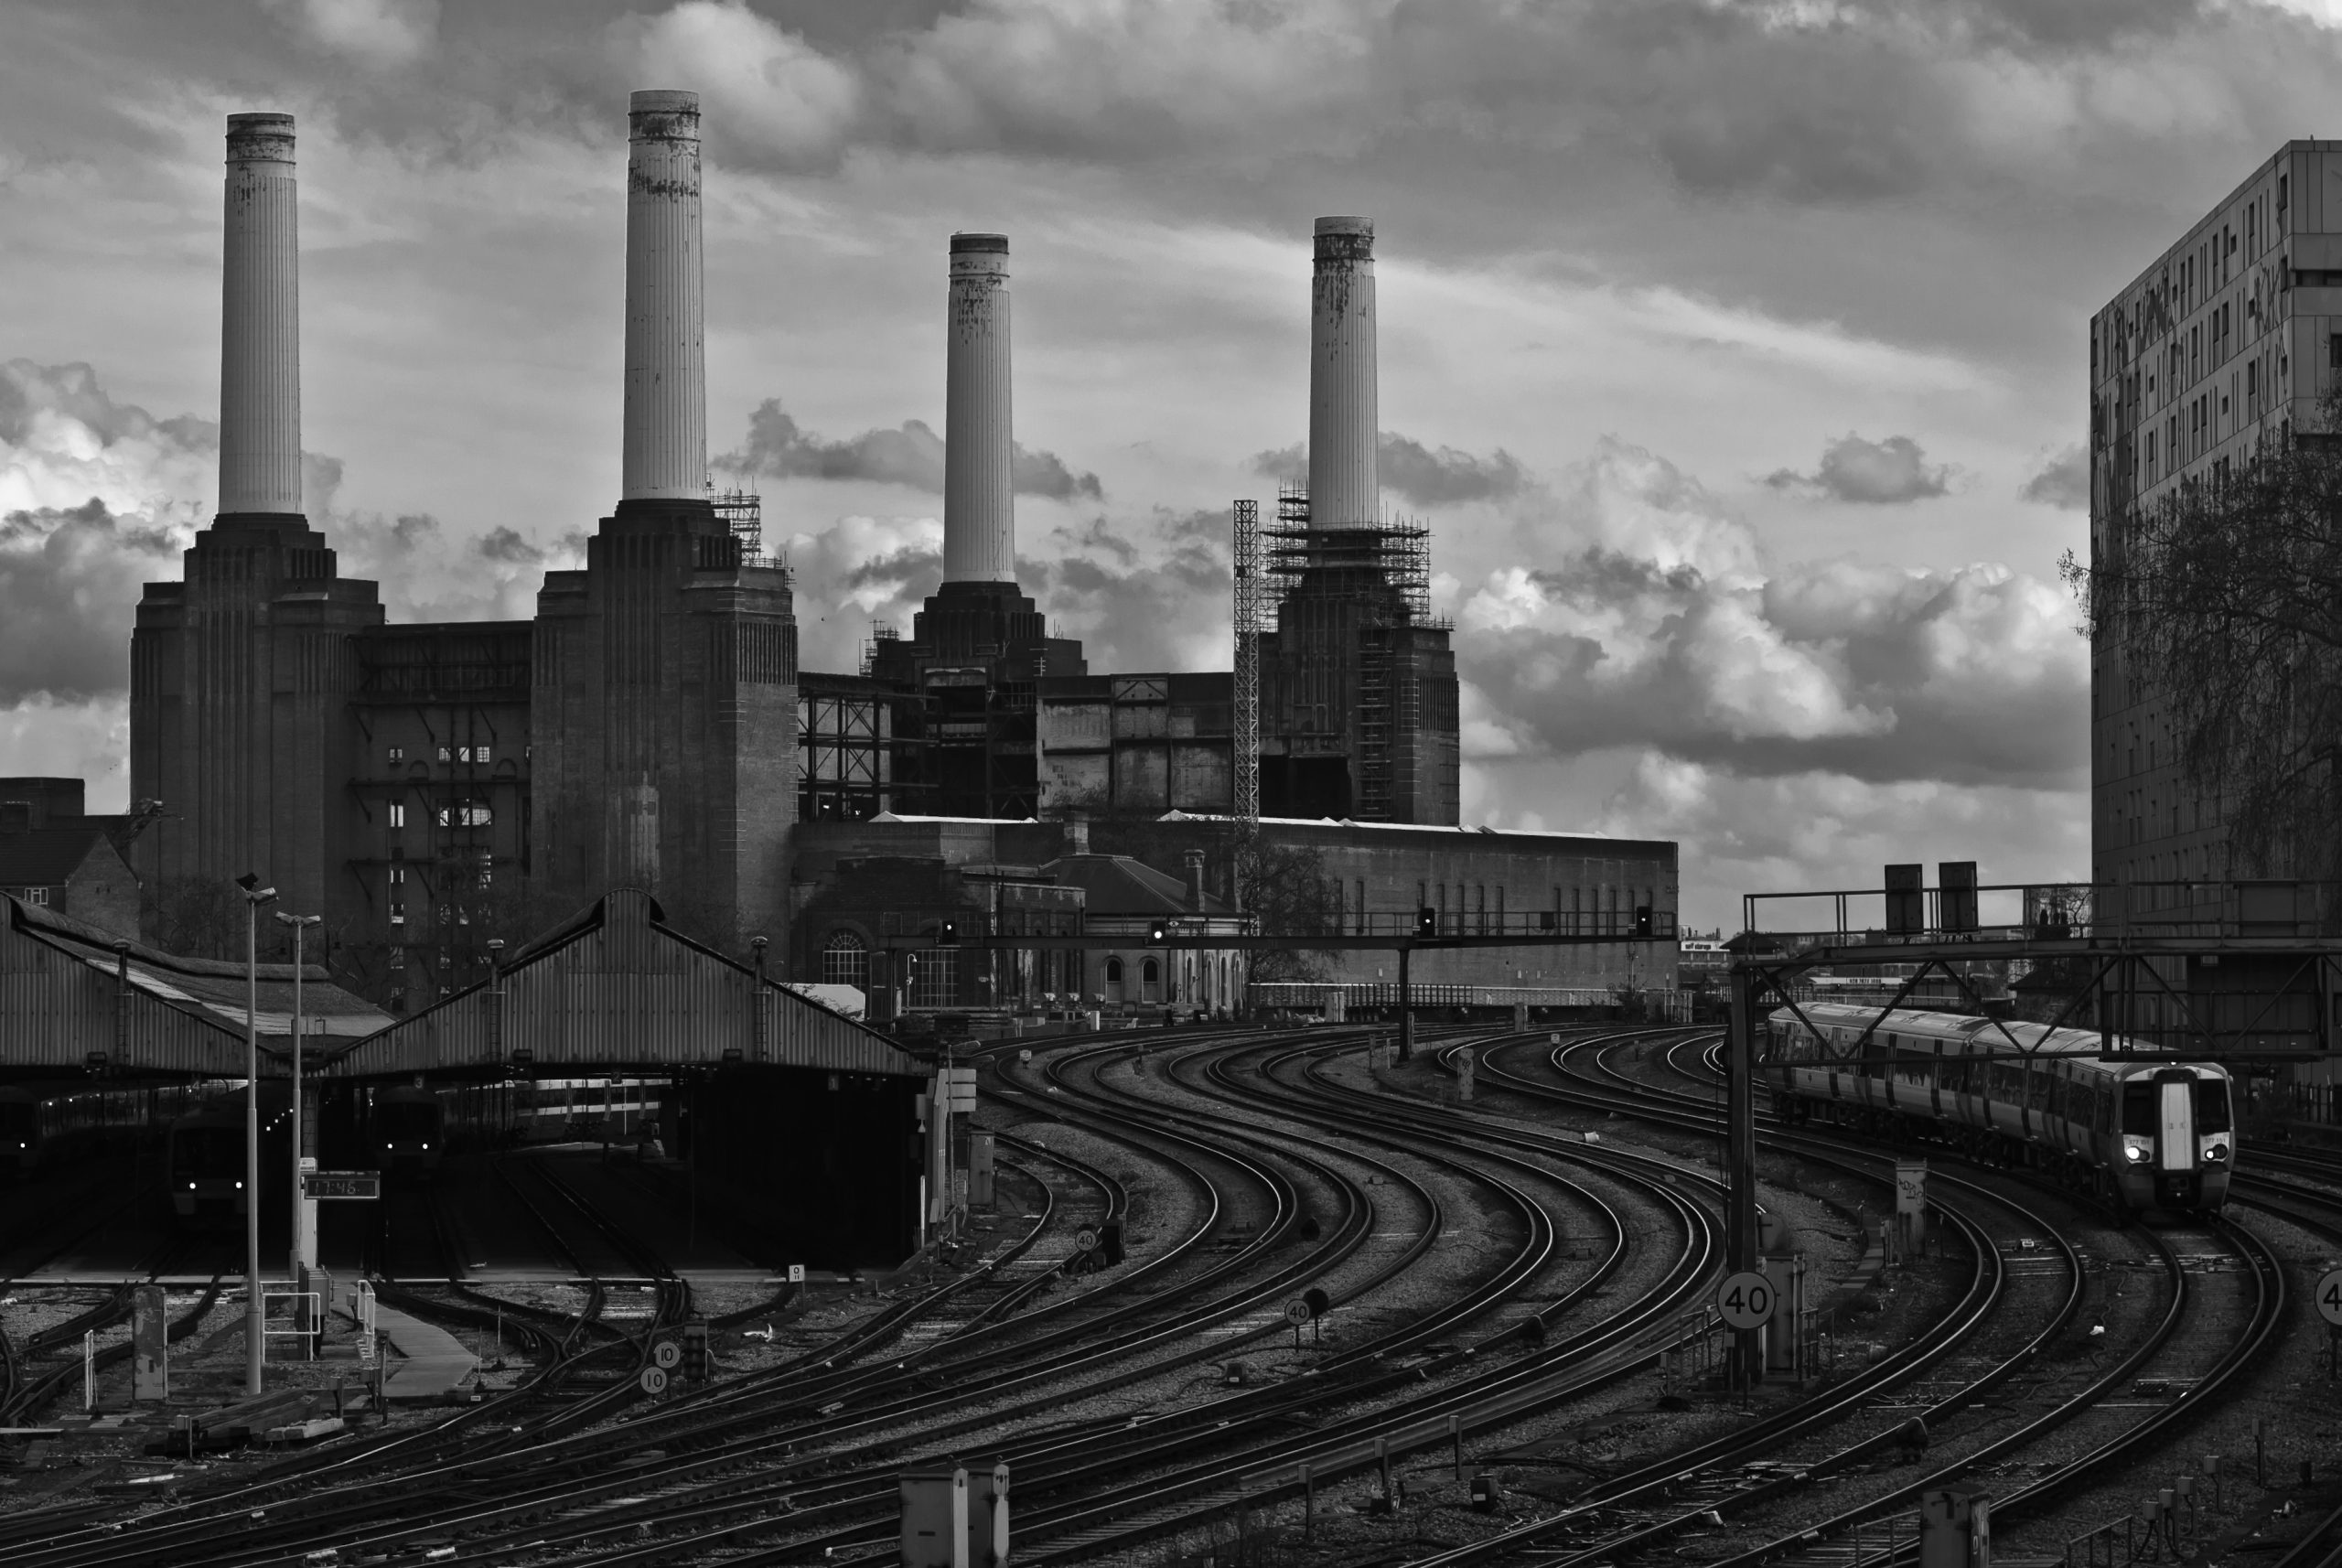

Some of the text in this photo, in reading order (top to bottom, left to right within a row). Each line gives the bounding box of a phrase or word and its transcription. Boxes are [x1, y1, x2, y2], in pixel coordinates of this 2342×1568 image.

[192, 1080, 199, 1090] 4
[415, 1078, 423, 1089] 3
[1079, 1235, 1093, 1246] 40
[1724, 1285, 1767, 1316] 40
[2323, 1283, 2342, 1312] 4
[1289, 1305, 1307, 1319] 40
[661, 1348, 674, 1362] 10
[647, 1373, 663, 1389] 10
